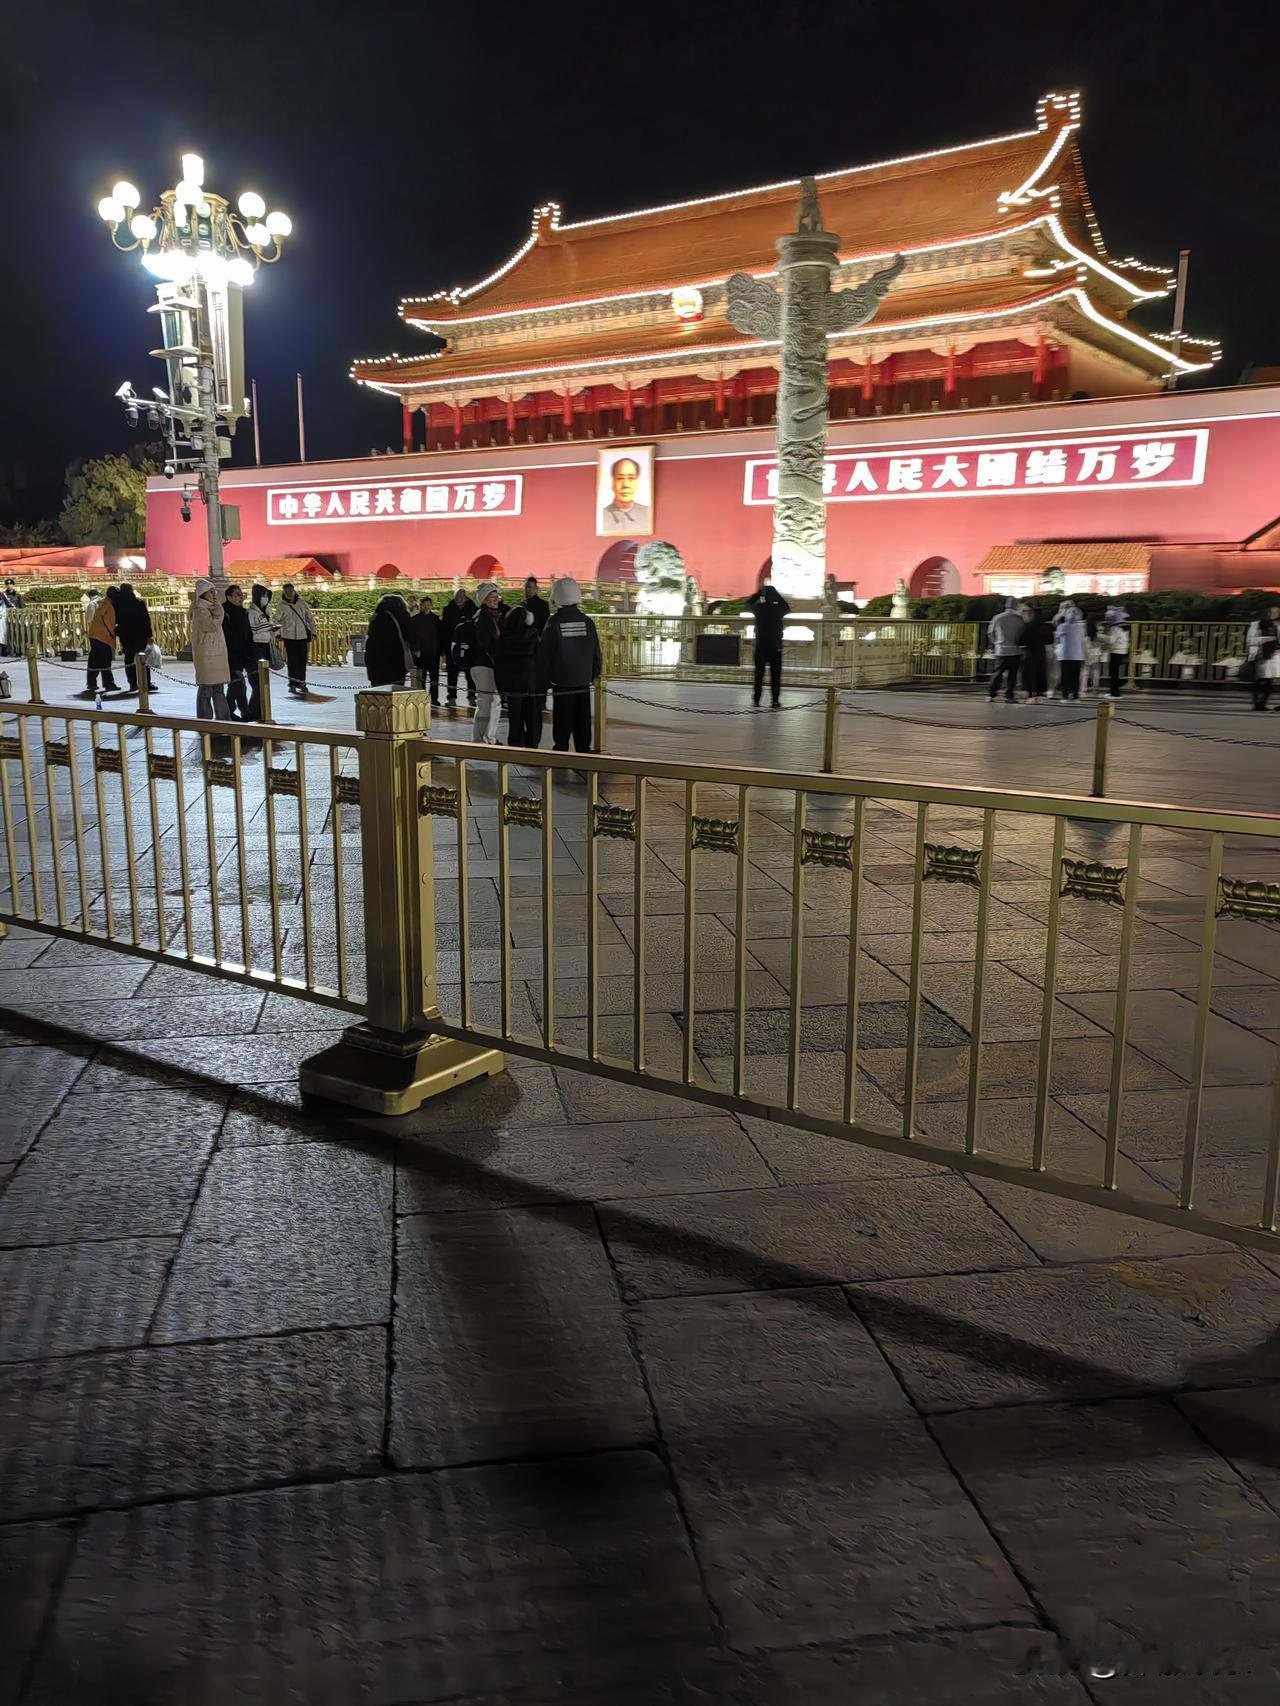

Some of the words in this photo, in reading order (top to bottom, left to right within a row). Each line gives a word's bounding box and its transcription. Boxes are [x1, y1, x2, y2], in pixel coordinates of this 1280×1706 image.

[278, 483, 506, 518] 中华人民共和国万岁
